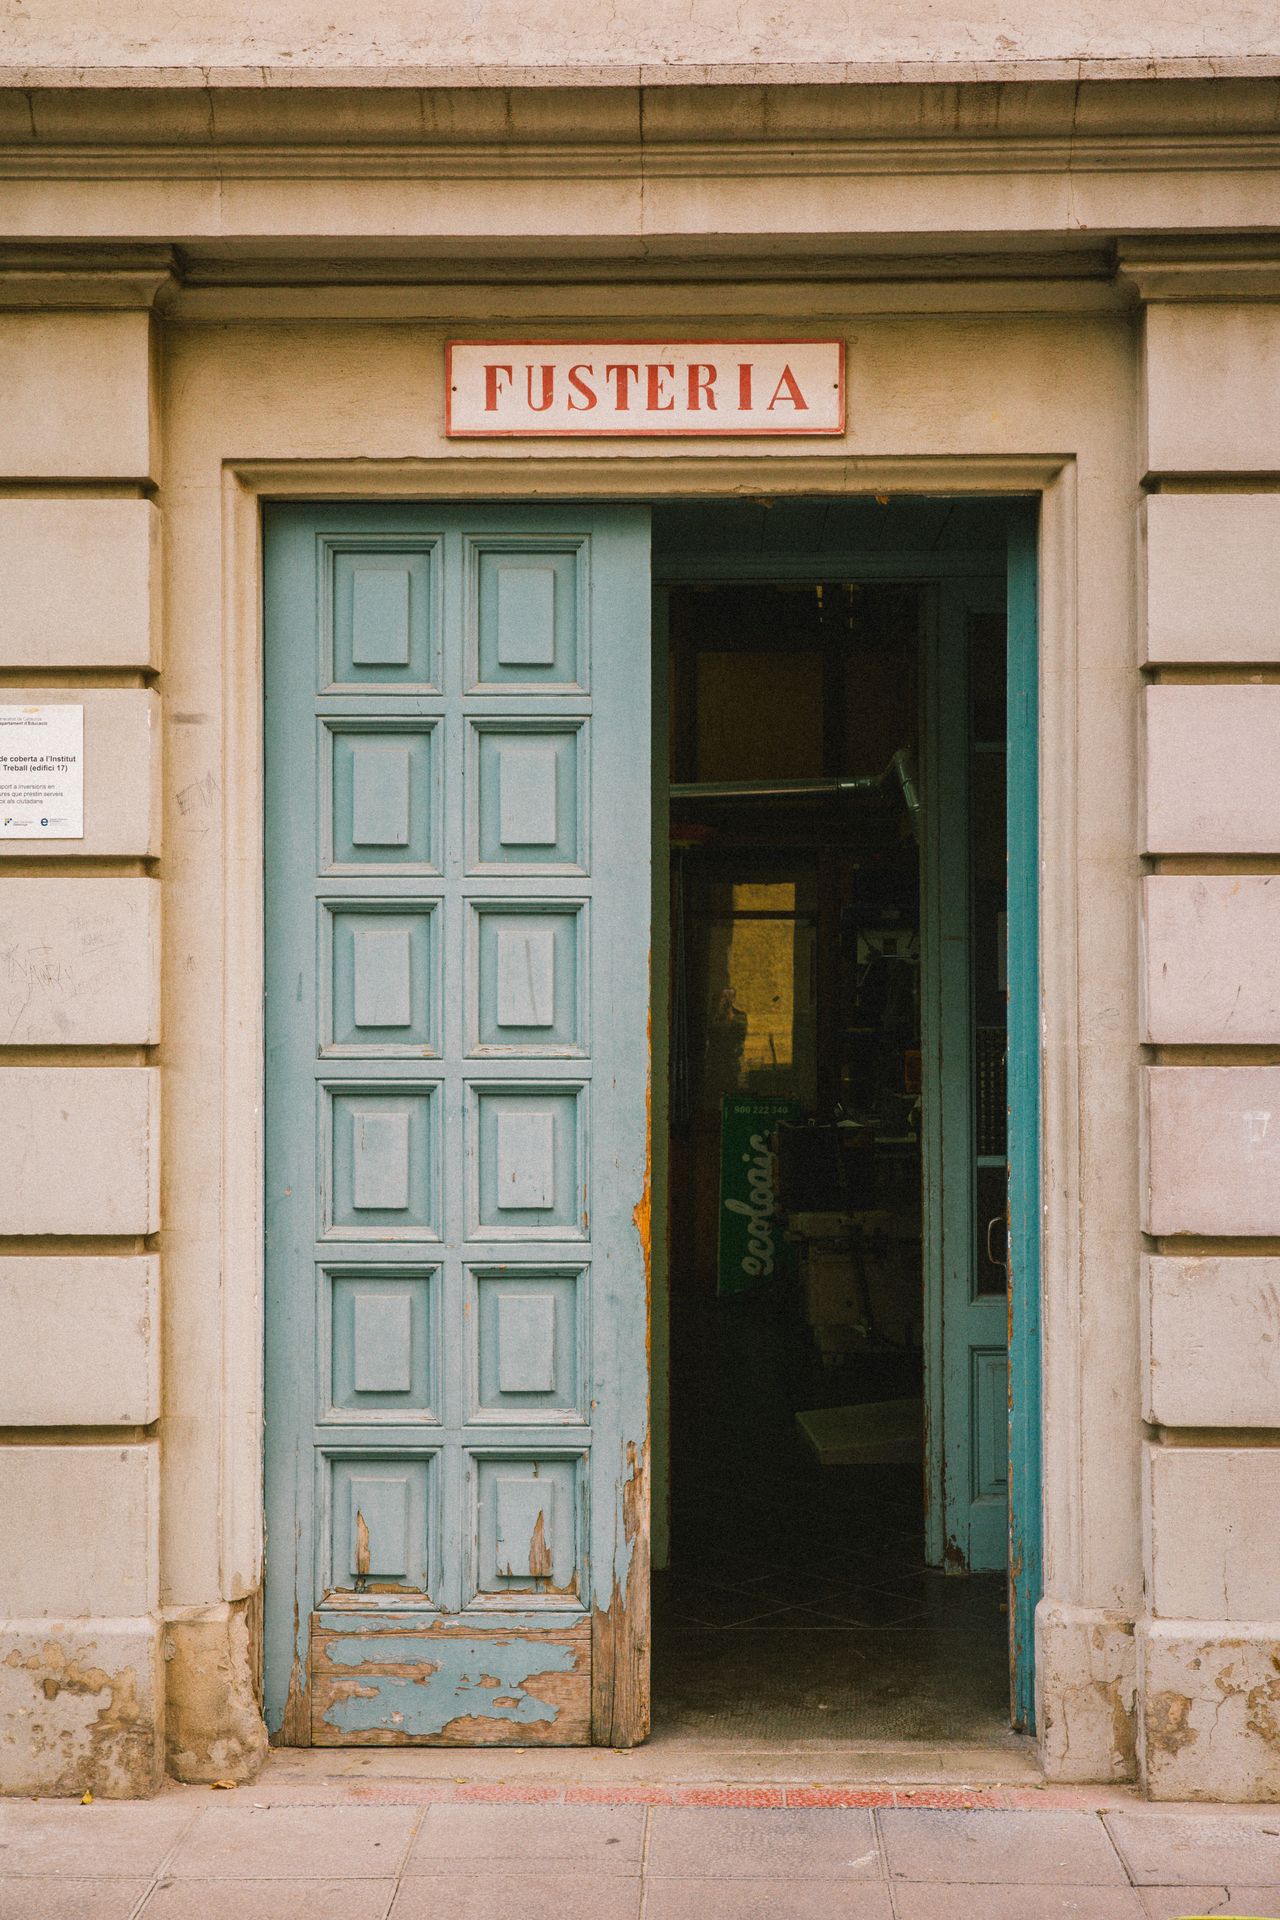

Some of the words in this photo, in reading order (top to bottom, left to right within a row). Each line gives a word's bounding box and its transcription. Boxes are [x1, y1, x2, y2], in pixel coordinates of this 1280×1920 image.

[483, 363, 810, 412] FUSTERIA
[9, 755, 38, 763] coberta
[46, 755, 76, 763] l'Institut
[3, 764, 28, 772] Treball
[29, 764, 55, 773] (edifici
[57, 764, 68, 773] 17)
